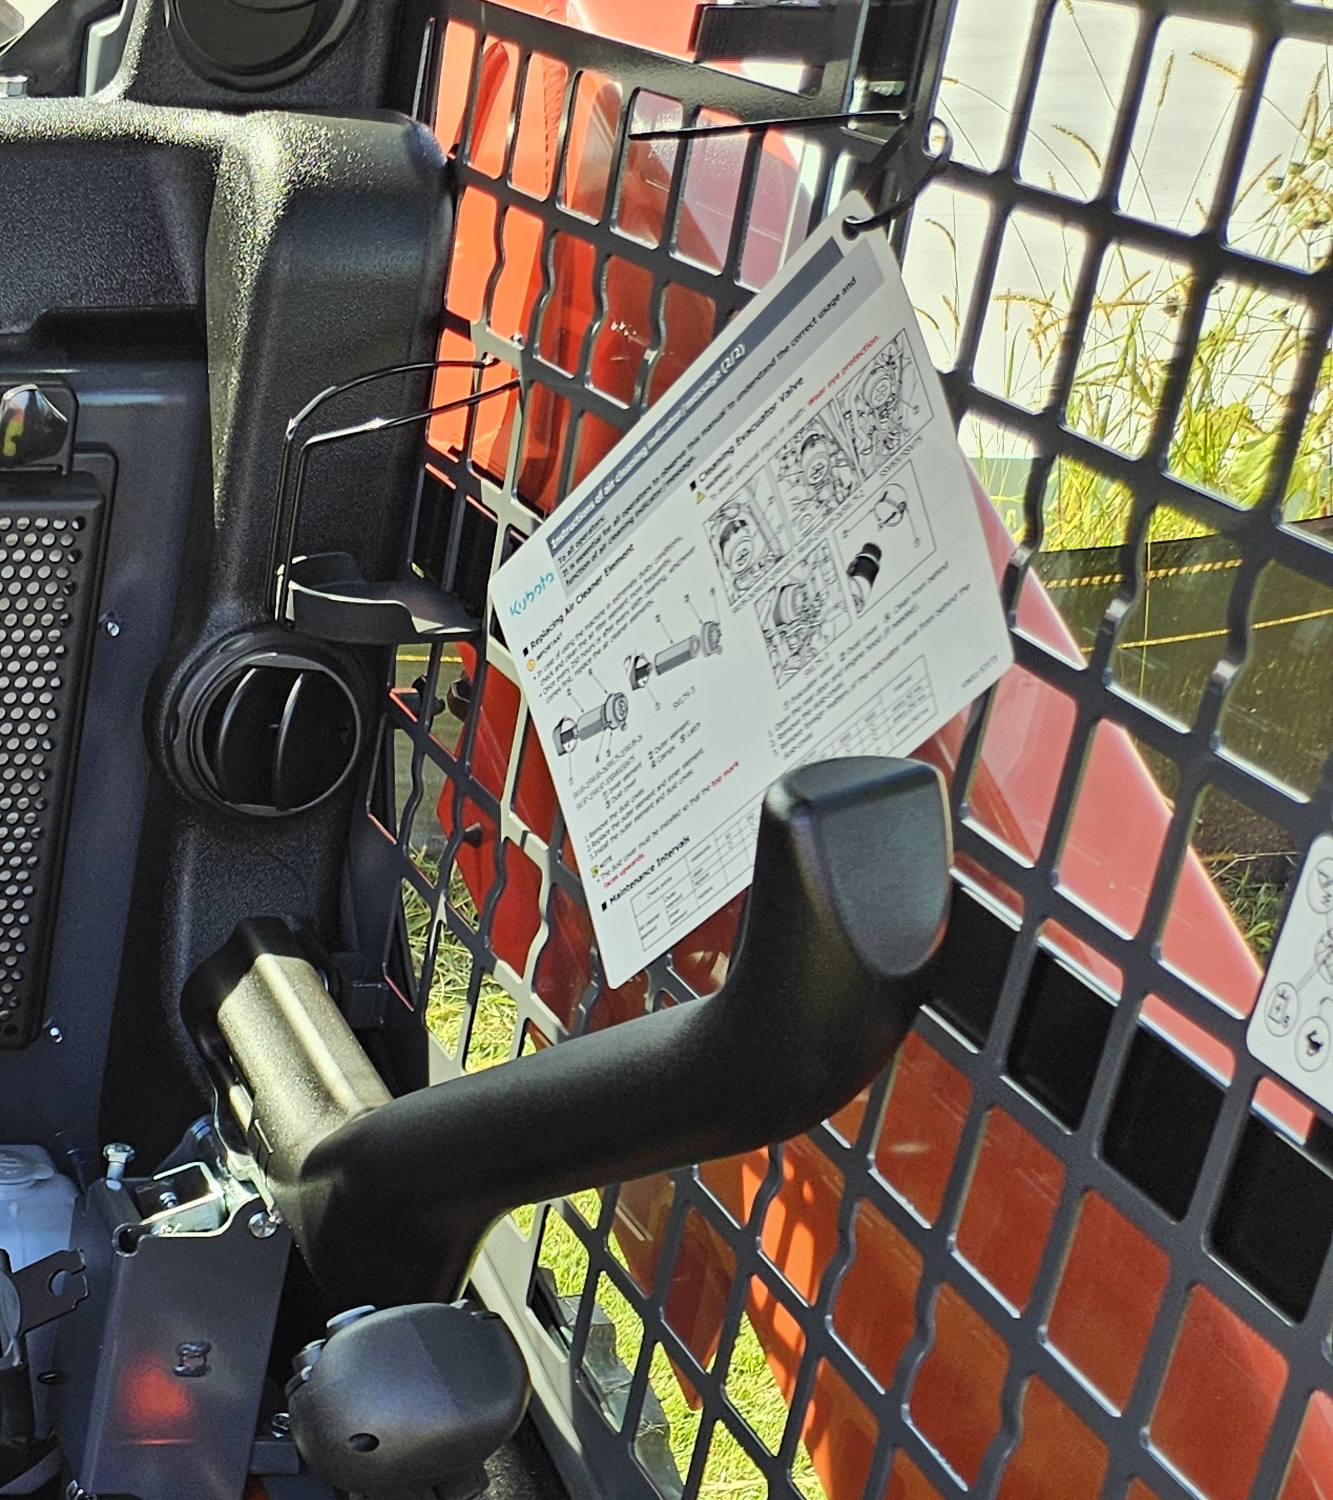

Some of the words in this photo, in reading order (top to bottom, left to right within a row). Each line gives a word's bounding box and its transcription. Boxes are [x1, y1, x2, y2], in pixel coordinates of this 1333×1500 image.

[789, 315, 817, 348] correct
[816, 291, 841, 322] usage
[840, 274, 856, 296] and
[806, 384, 826, 408] Wear
[827, 372, 840, 389] eye
[698, 442, 735, 483] Cleaning
[735, 400, 778, 448] Evacuator
[779, 374, 804, 404] Valve
[557, 551, 566, 566] To
[566, 543, 575, 557] all
[574, 512, 606, 550] operators:
[509, 566, 554, 621] Kubota
[529, 611, 564, 651] Replacing
[564, 600, 575, 616] Air
[575, 572, 604, 605] Cleaner
[603, 541, 635, 578] Element
[609, 860, 655, 907] Maintenance
[655, 831, 690, 867] Intervals
